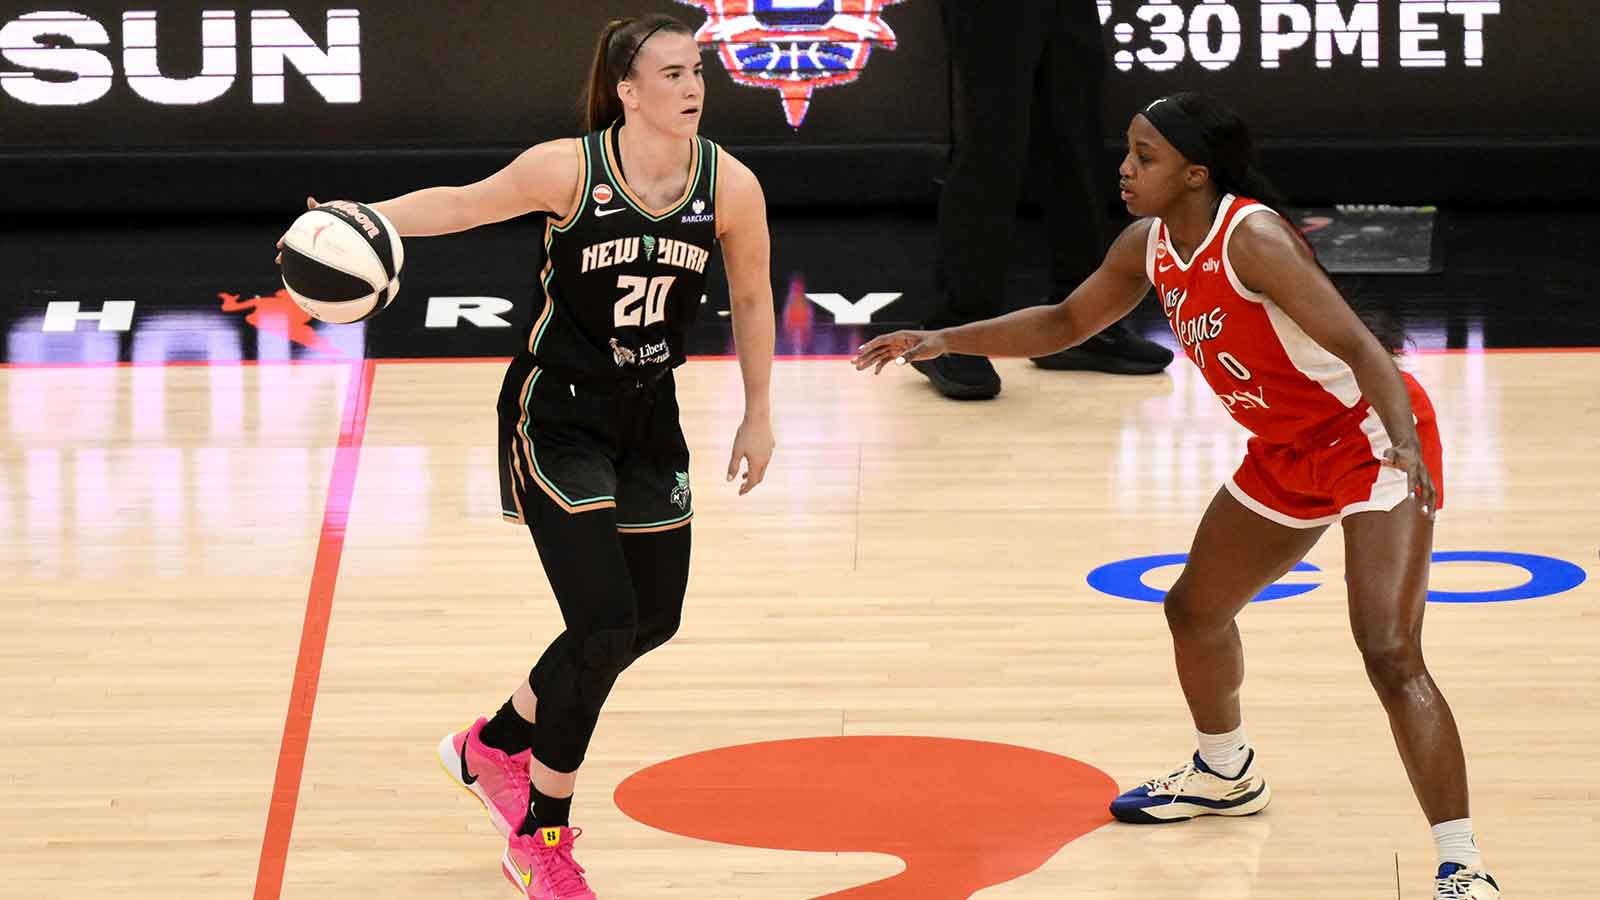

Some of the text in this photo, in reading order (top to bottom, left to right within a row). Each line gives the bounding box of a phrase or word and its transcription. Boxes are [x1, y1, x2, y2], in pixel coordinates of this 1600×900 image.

[1260, 0, 1379, 68] PM
[1400, 0, 1500, 68] ET
[0, 9, 361, 105] SUN
[681, 214, 714, 224] BARCLAYS
[580, 236, 710, 275] NEW YORK
[1202, 257, 1221, 274] ally
[613, 275, 678, 328] 20
[1161, 283, 1180, 318] Las
[1173, 288, 1228, 369] Vegas
[1216, 351, 1252, 381] 0
